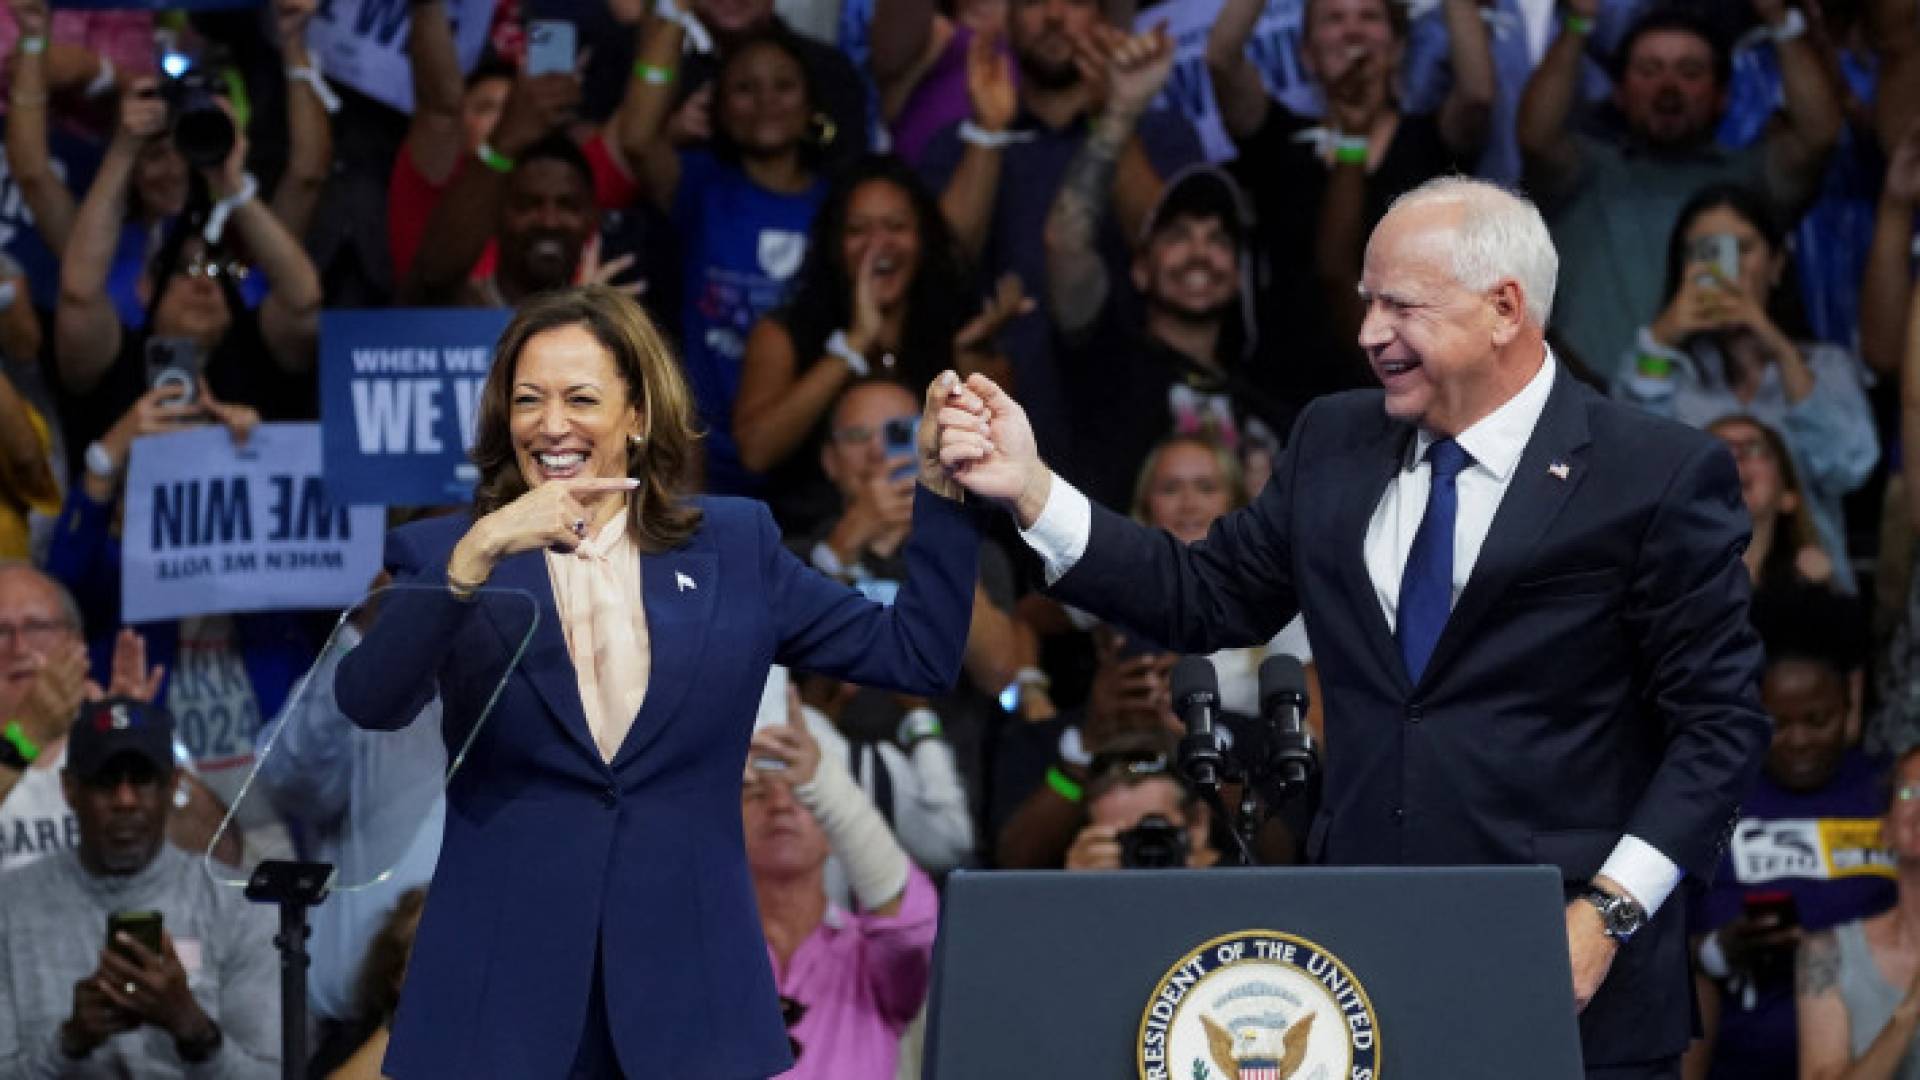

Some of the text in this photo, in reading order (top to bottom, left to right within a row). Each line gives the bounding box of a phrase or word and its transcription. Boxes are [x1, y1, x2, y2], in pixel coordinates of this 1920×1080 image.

[353, 348, 489, 372] WHEN WE
[351, 378, 443, 454] WE
[152, 474, 351, 551] WE WIN
[156, 551, 343, 579] WHEN WE VOTE
[183, 699, 259, 757] 024
[1217, 942, 1245, 963] OF
[1253, 939, 1297, 962] THE
[1306, 953, 1373, 1050] UNITED
